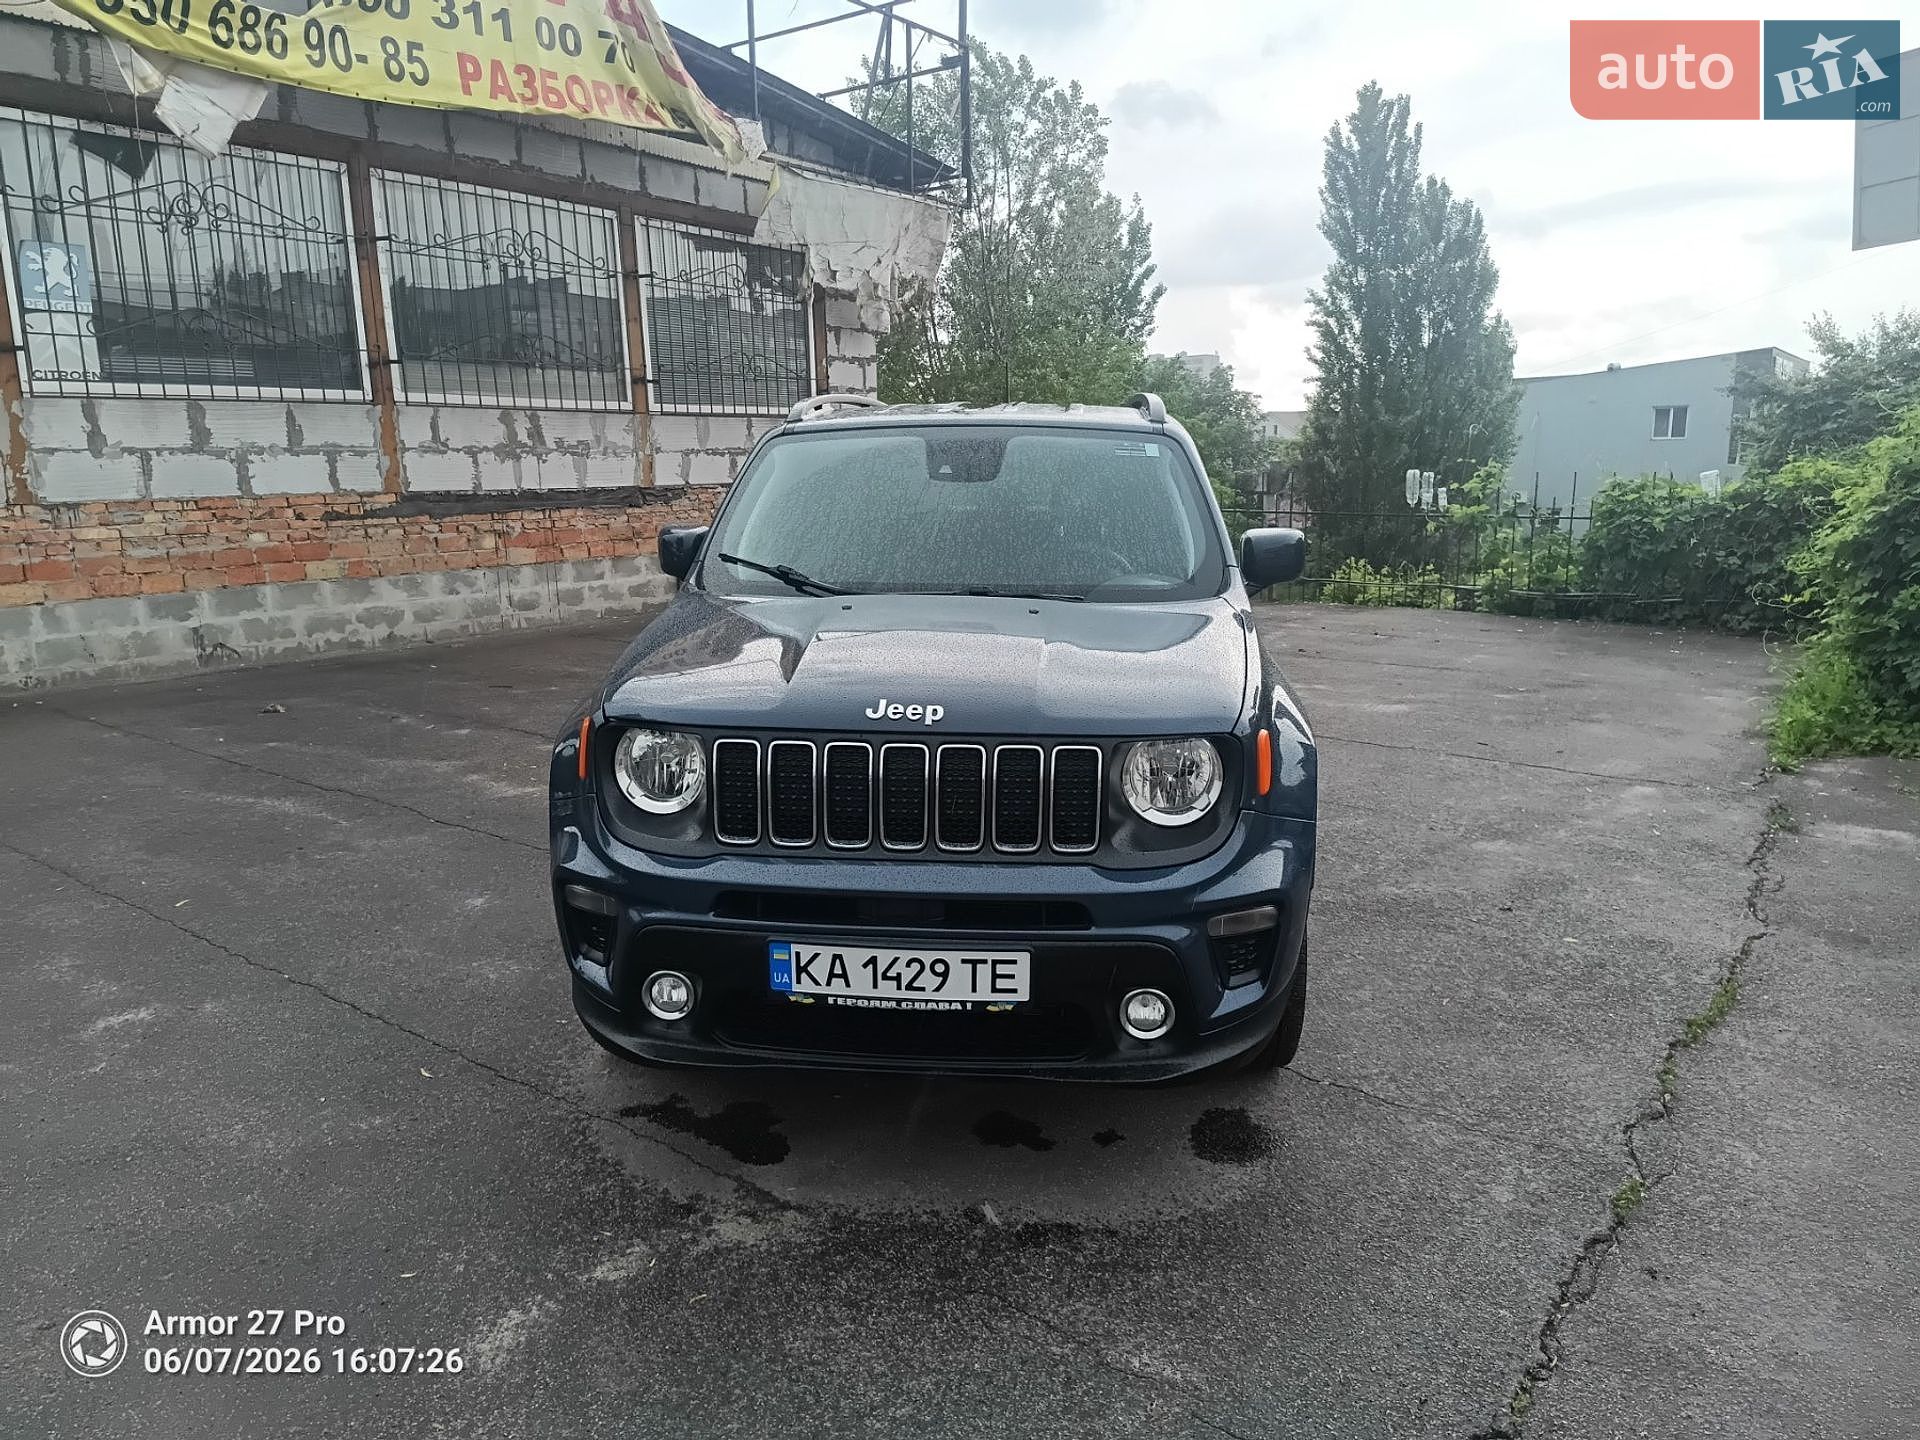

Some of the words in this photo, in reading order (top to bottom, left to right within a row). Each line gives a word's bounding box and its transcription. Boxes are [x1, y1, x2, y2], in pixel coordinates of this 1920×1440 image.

[208, 0, 289, 60] 686
[432, 0, 512, 43] 311
[535, 16, 583, 57] 00
[865, 699, 944, 726] Jeep
[774, 972, 790, 984] UA
[794, 951, 851, 988] KA
[861, 955, 950, 993] 1429
[961, 958, 1018, 994] TE
[827, 996, 897, 1010] ГЕРОЯМ
